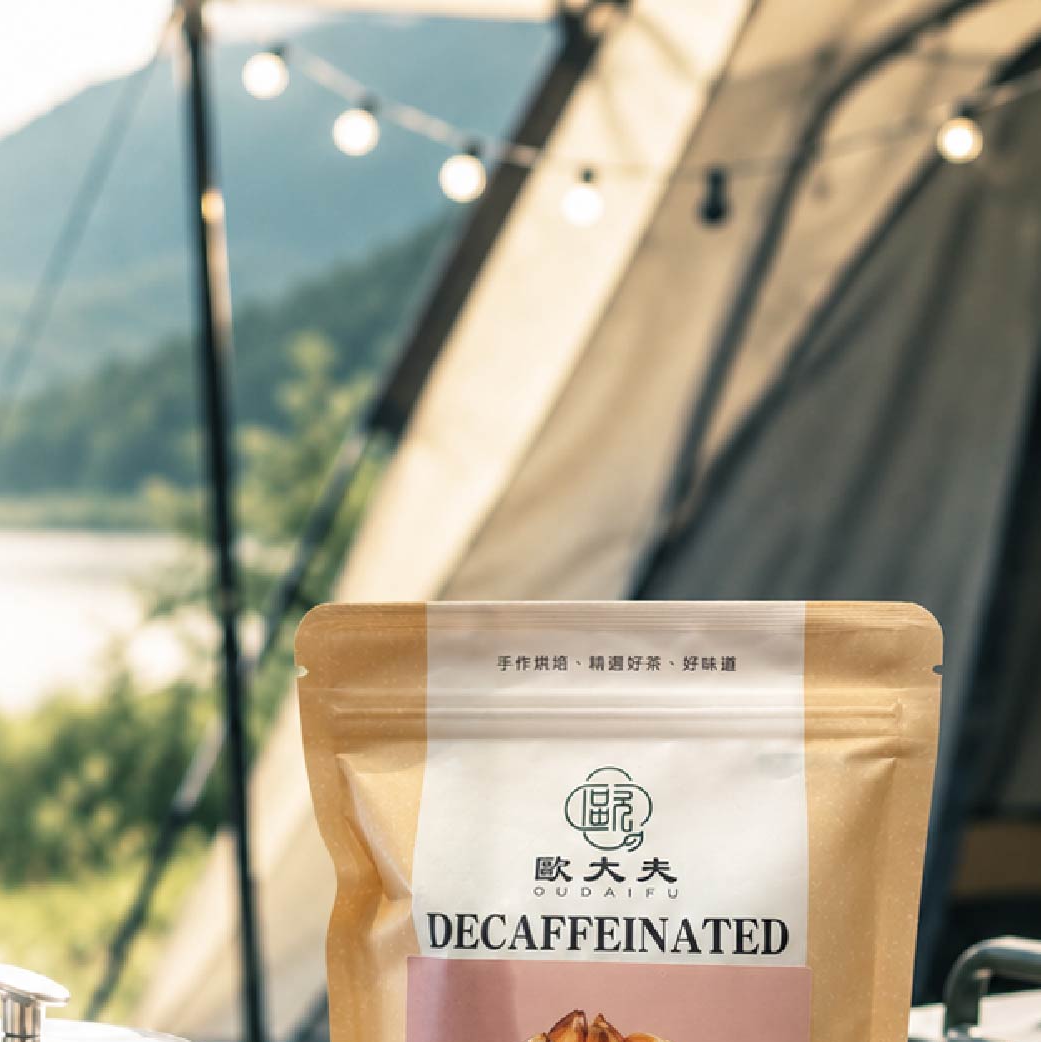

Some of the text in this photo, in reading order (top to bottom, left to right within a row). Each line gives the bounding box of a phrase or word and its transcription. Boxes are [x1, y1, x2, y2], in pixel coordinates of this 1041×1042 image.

[534, 856, 678, 884] 歐大夫
[533, 886, 678, 899] OUDAIFU
[427, 912, 789, 955] DECAFFEINATED
